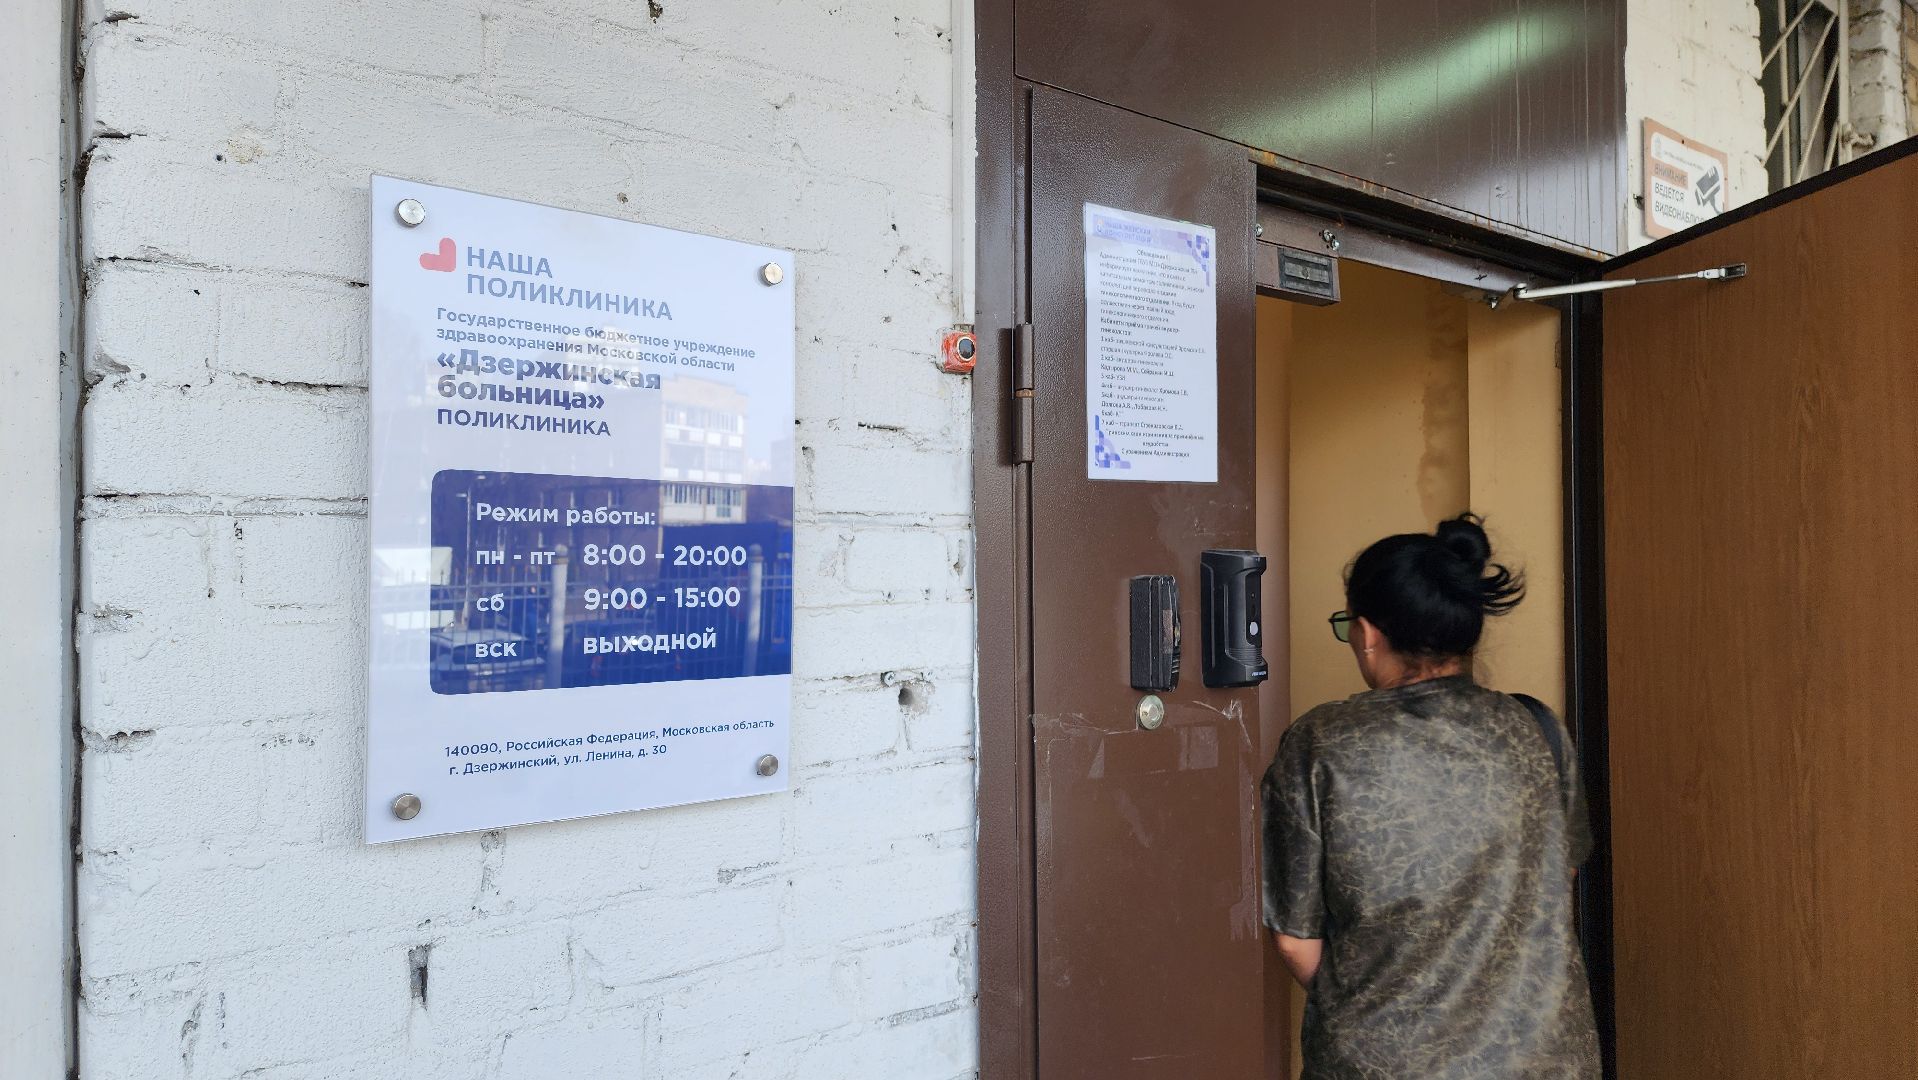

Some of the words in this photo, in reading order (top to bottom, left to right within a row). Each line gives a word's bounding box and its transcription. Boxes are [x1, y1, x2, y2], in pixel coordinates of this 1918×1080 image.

[1655, 182, 1685, 202] ВЕДЕТСЯ
[468, 246, 552, 278] НАША
[468, 274, 672, 320] ПОЛИКЛИНИКА
[437, 307, 580, 337] Государственное
[585, 326, 668, 348] бюджетное
[674, 339, 755, 358] учреждение
[437, 329, 582, 354] здравоохранения
[588, 343, 676, 367] Московской
[681, 357, 735, 372] области
[438, 349, 660, 389] «Дзержинская
[438, 376, 604, 410] больница»
[438, 409, 610, 437] ПОЛИКЛИНИКА
[476, 503, 558, 523] Режим
[567, 506, 655, 526] работы:
[476, 550, 504, 566] пн
[530, 550, 555, 565] пт
[584, 544, 646, 566] 8:00
[674, 545, 747, 566] 20:00
[476, 593, 504, 612] сб
[584, 588, 647, 610] 9:00
[675, 587, 740, 608] 15:00
[476, 642, 516, 657] вск
[584, 627, 716, 654] выходной
[445, 742, 502, 757] 140090,
[506, 734, 583, 751] Российская
[586, 729, 659, 748] Федерация,
[662, 723, 729, 738] Московская
[733, 718, 774, 731] область
[449, 765, 458, 775] г.
[463, 755, 559, 776] Дзержинский,
[564, 752, 582, 765] ул.
[586, 747, 634, 763] Ленина,
[638, 746, 648, 757] д.
[652, 744, 667, 754] 30
